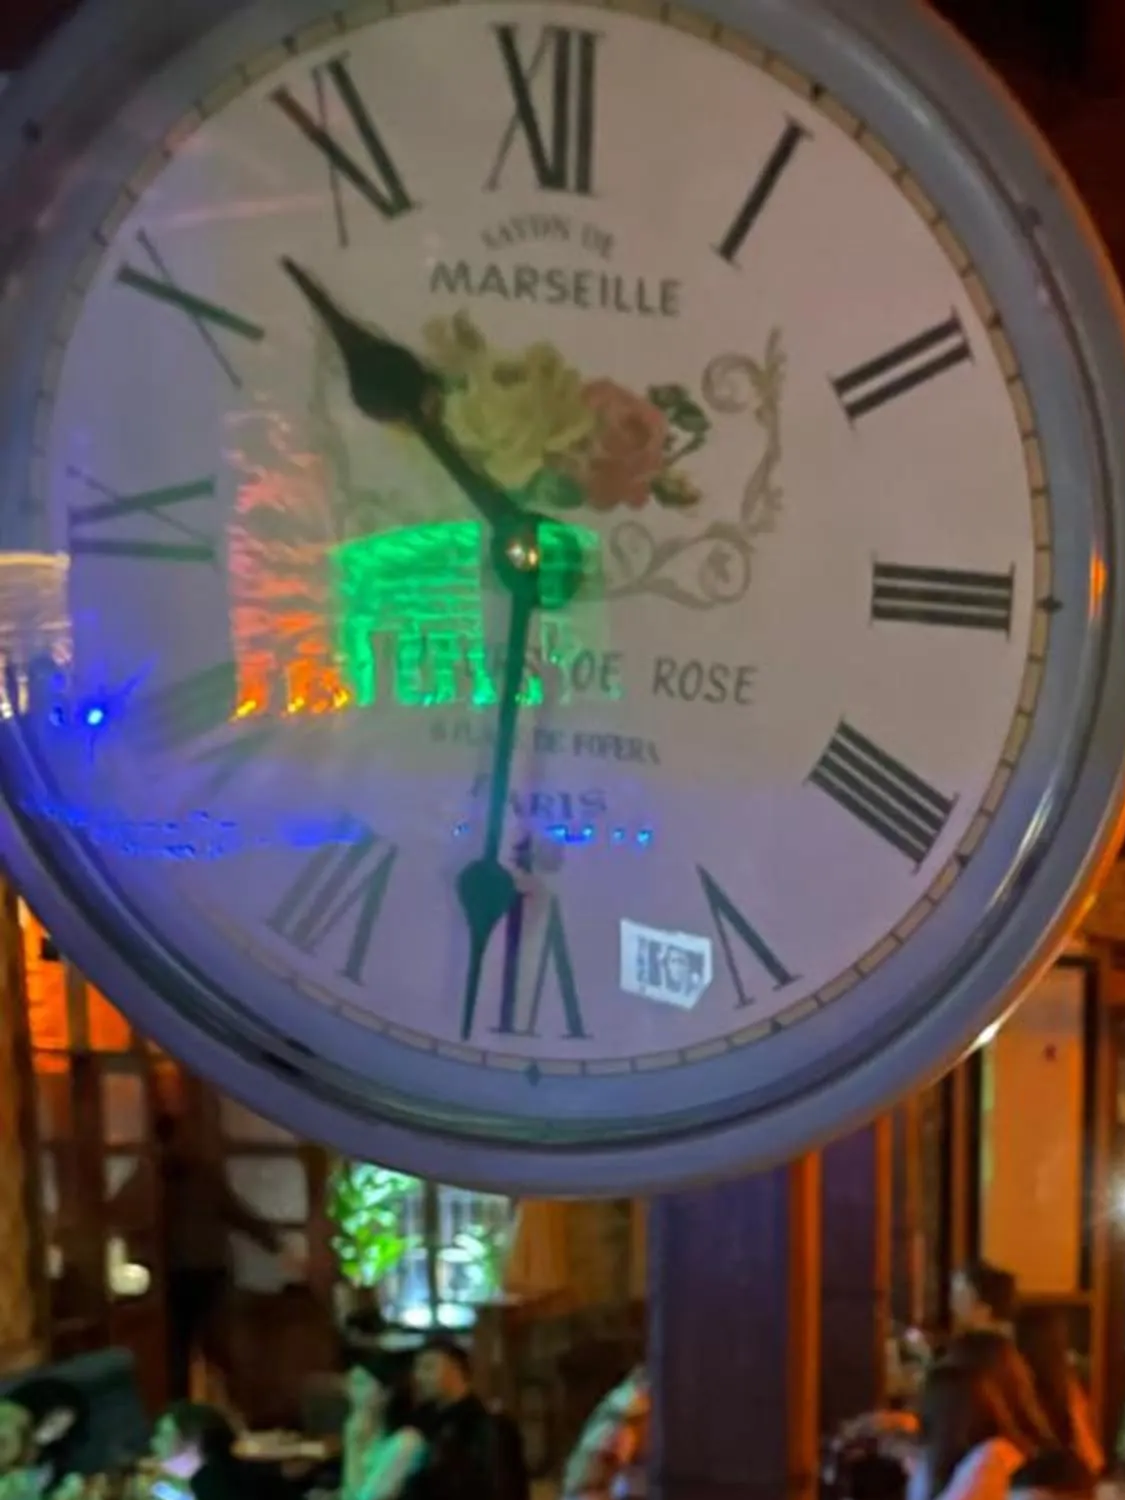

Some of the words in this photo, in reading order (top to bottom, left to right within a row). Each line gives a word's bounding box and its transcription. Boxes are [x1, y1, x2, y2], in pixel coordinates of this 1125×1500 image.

[267, 52, 418, 248] XI
[485, 22, 604, 195] XII
[116, 226, 266, 390] X
[429, 259, 682, 318] MARSEILLE
[653, 655, 758, 705] ROSE
